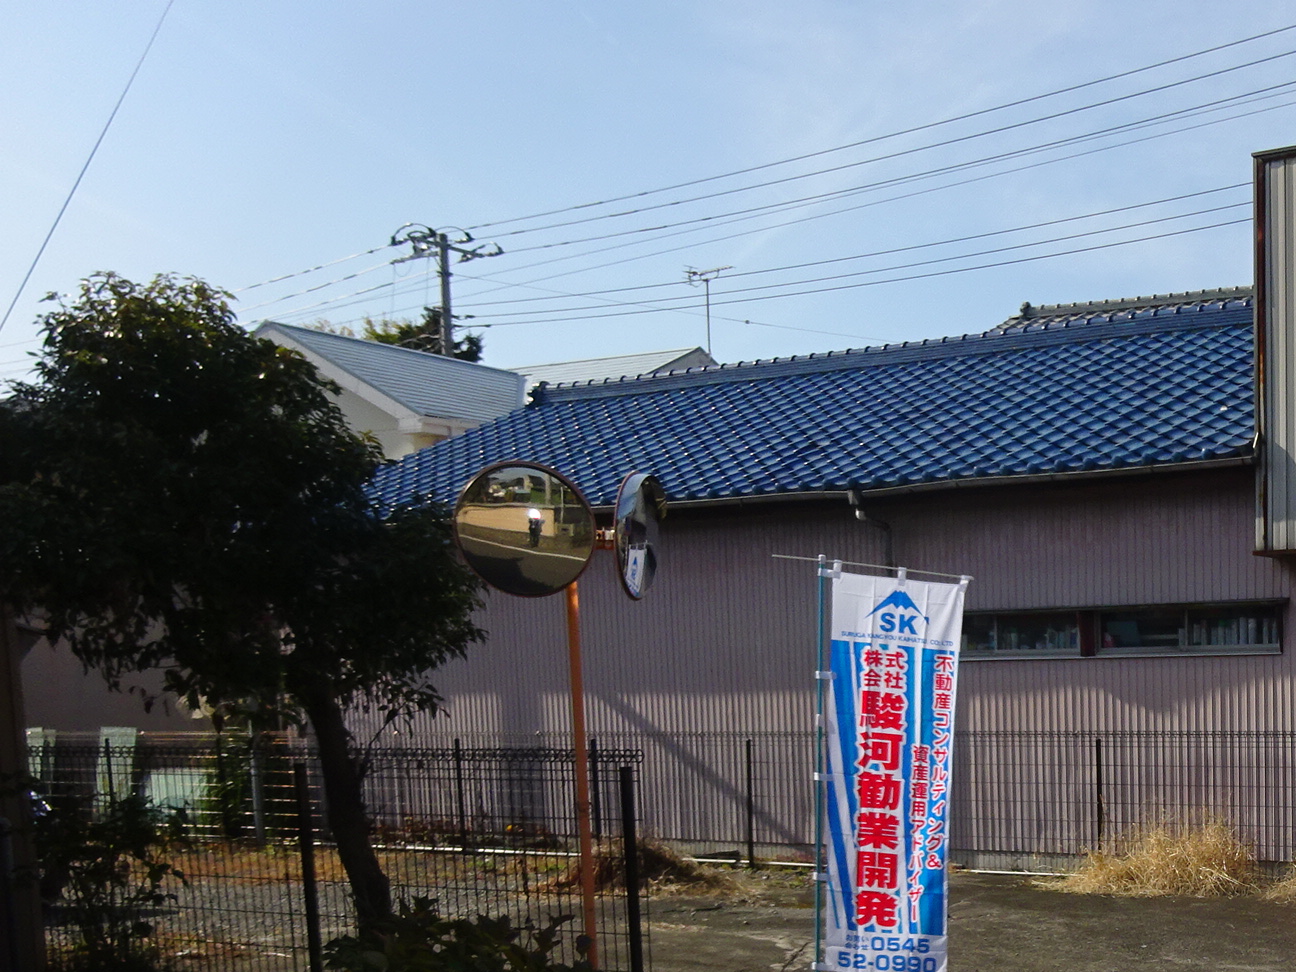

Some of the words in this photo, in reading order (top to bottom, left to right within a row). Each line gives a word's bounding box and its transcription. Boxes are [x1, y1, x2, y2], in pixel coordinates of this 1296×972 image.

[879, 612, 918, 635] SK
[856, 691, 905, 927] 駿河勧業開発
[909, 746, 929, 921] 資産運用アドバイザー
[926, 655, 953, 868] 不動産コンサルティング&
[871, 936, 930, 954] 0545
